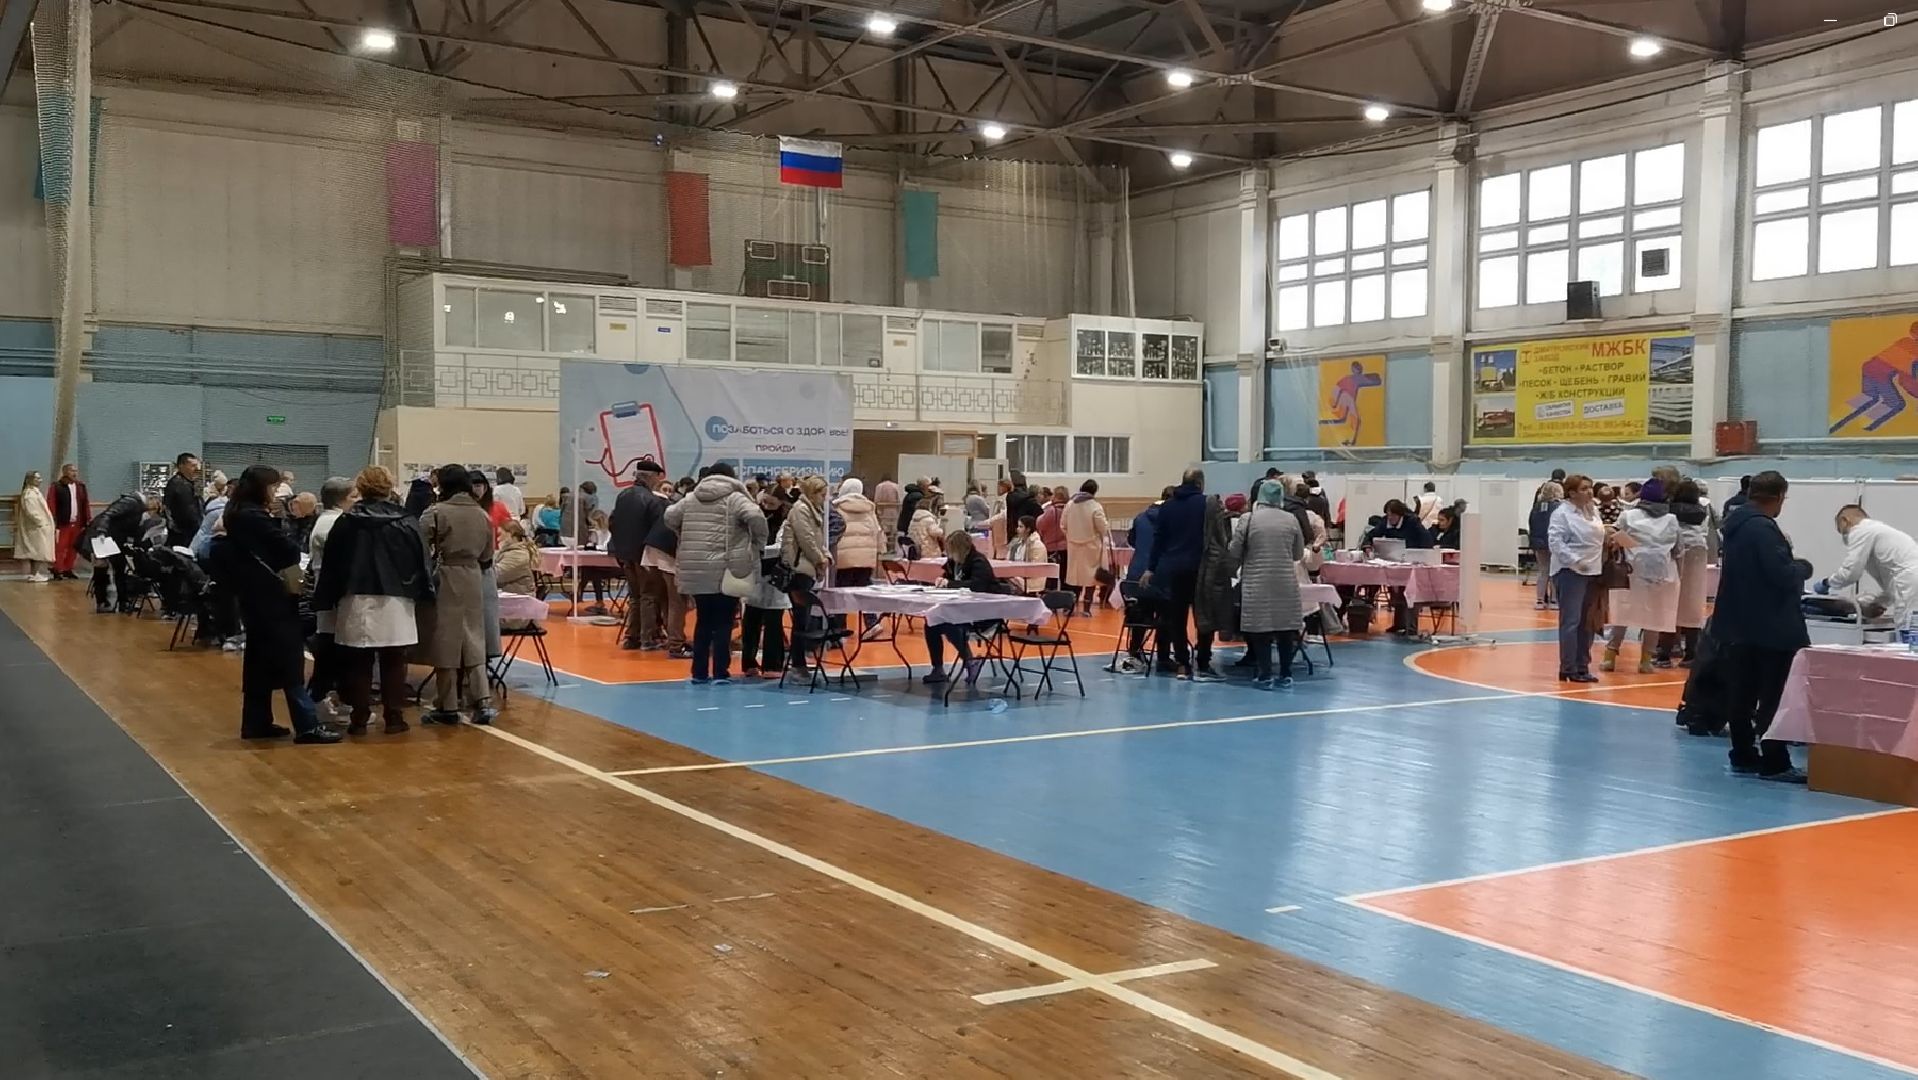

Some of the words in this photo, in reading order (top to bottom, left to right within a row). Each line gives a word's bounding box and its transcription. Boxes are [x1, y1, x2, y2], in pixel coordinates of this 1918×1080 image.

[1592, 339, 1647, 357] МЖБК
[1543, 364, 1571, 375] БЕТОН
[1580, 362, 1624, 373] РАСТВОР
[1521, 378, 1551, 388] ПЕСОК
[1558, 387, 1626, 399] КОНСТРУКЦИИ
[786, 427, 795, 436] О
[797, 427, 849, 437] ЗДОРВЬЕ!
[755, 443, 796, 453] ПРОЙДИ
